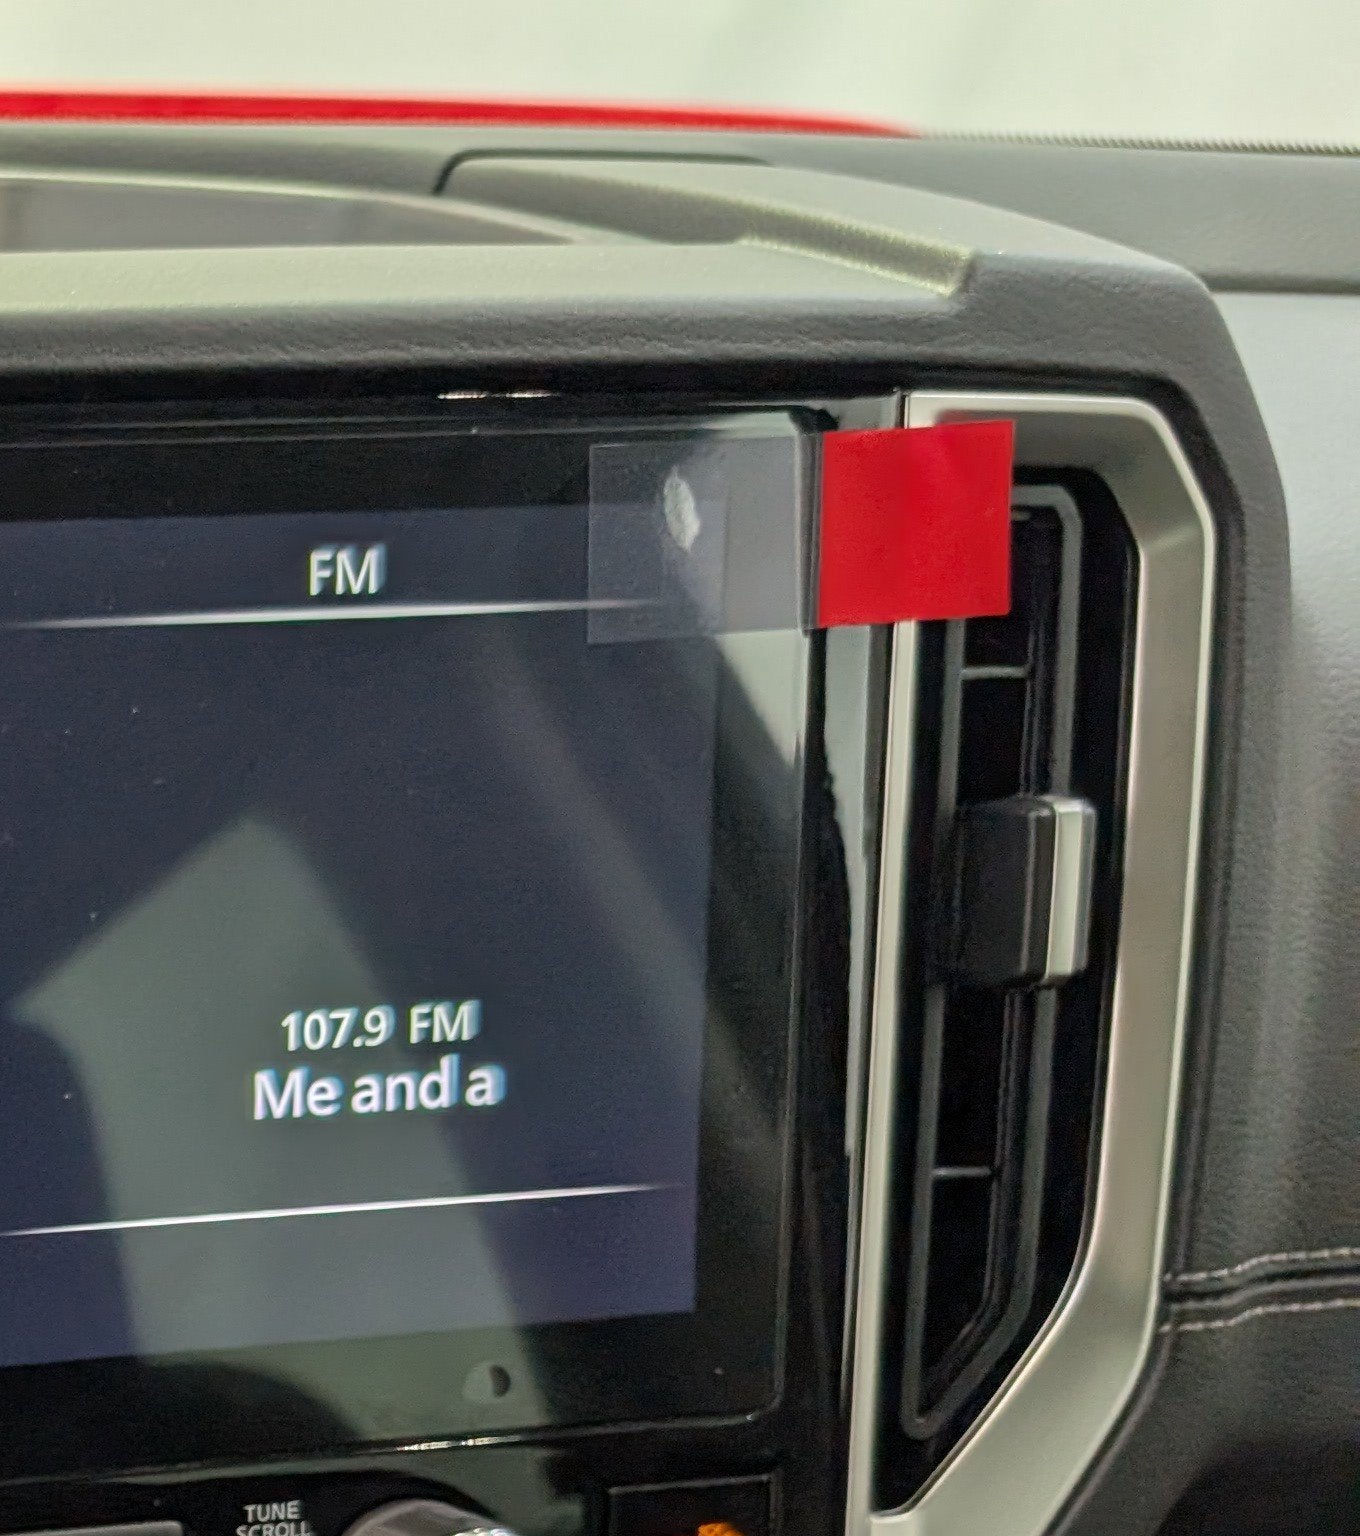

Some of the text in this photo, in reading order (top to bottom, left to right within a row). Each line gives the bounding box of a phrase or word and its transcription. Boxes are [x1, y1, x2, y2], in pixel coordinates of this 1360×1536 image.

[307, 546, 389, 598] FM
[281, 1002, 478, 1052] 107.9 FM
[253, 1056, 506, 1120] Me and a
[244, 1501, 301, 1524] TUNE
